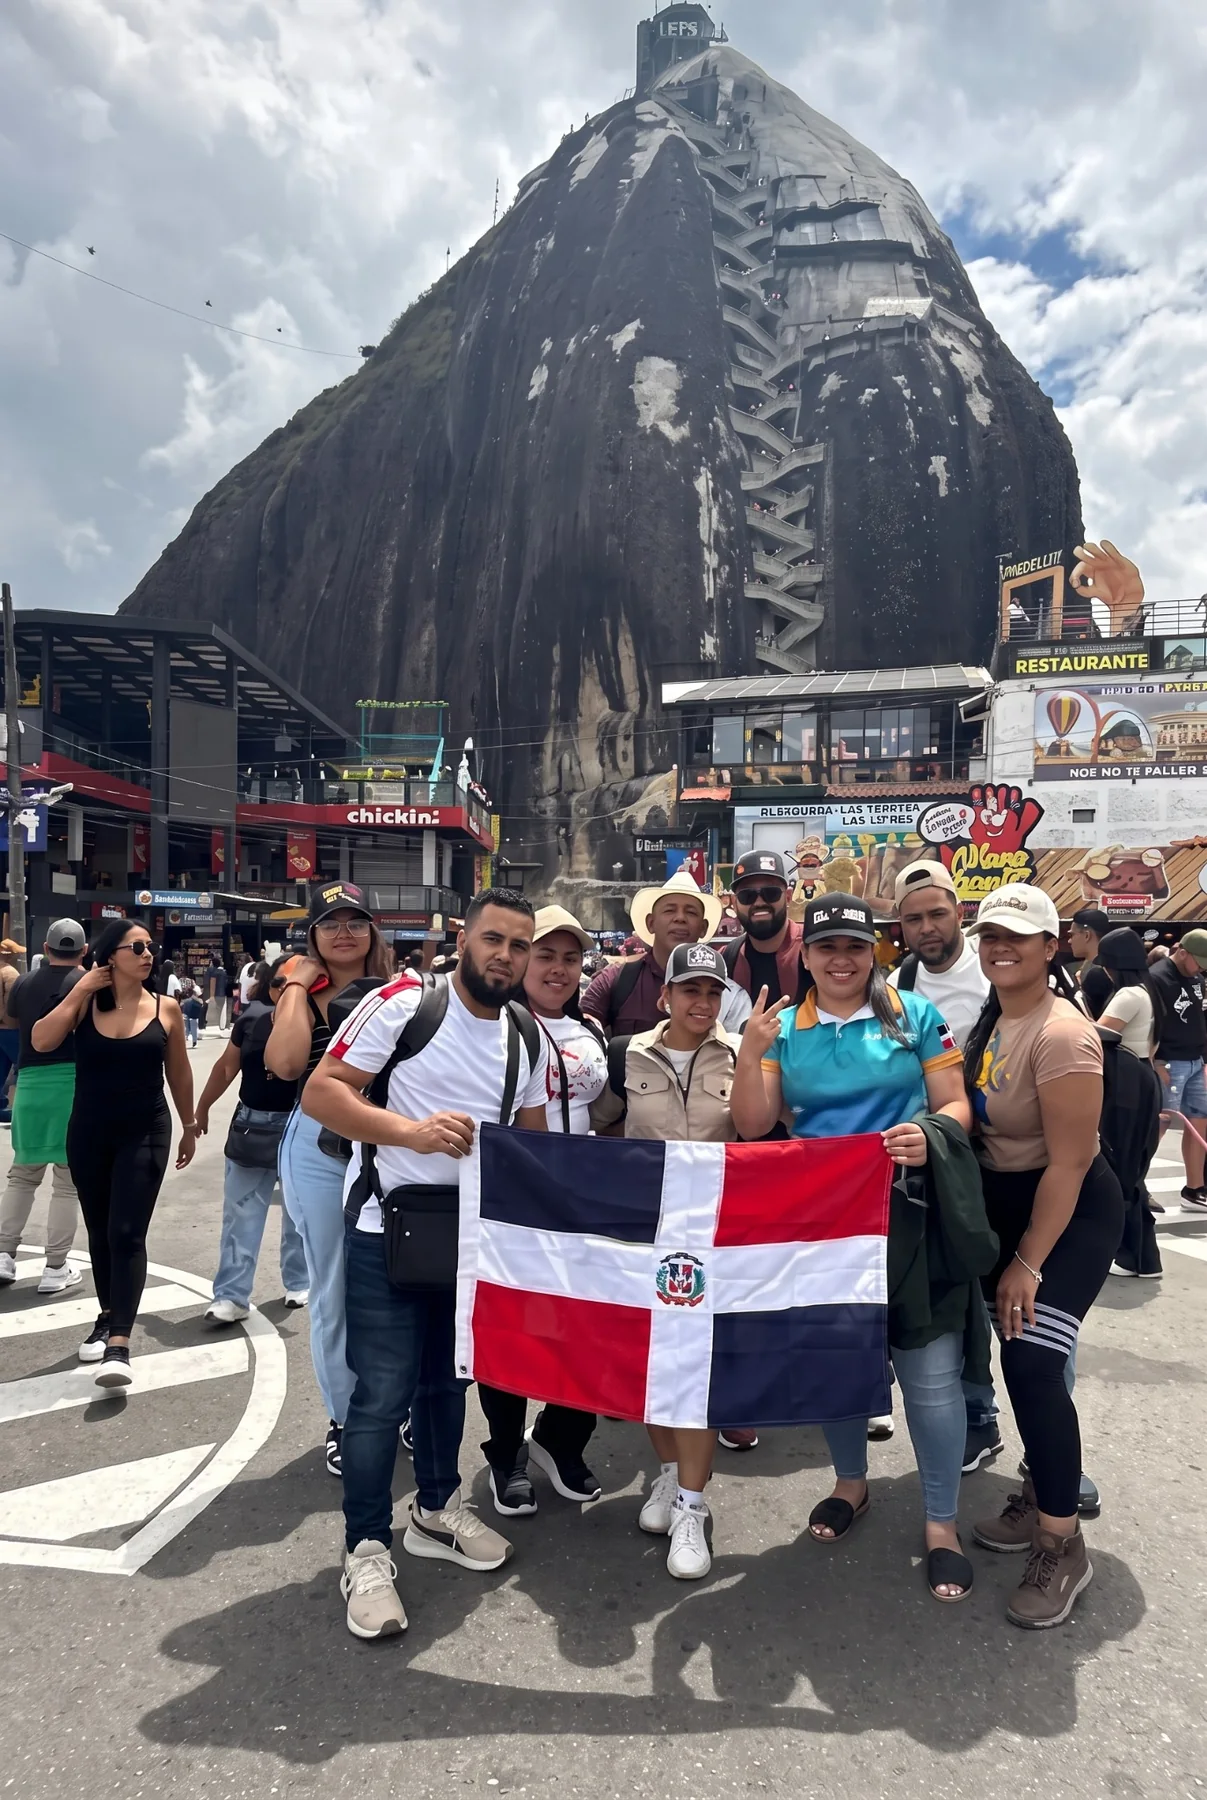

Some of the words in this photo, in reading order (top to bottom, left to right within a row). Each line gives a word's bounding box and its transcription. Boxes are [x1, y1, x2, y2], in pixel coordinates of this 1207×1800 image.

[1015, 653, 1149, 674] RESTAURANTE
[1069, 767, 1097, 778] NOE
[1101, 767, 1121, 777] NO
[1126, 766, 1140, 776] TE
[1145, 765, 1197, 776] PALLER
[840, 805, 863, 814] LAS
[867, 803, 920, 814] TERRTEA
[842, 816, 866, 825] LAS
